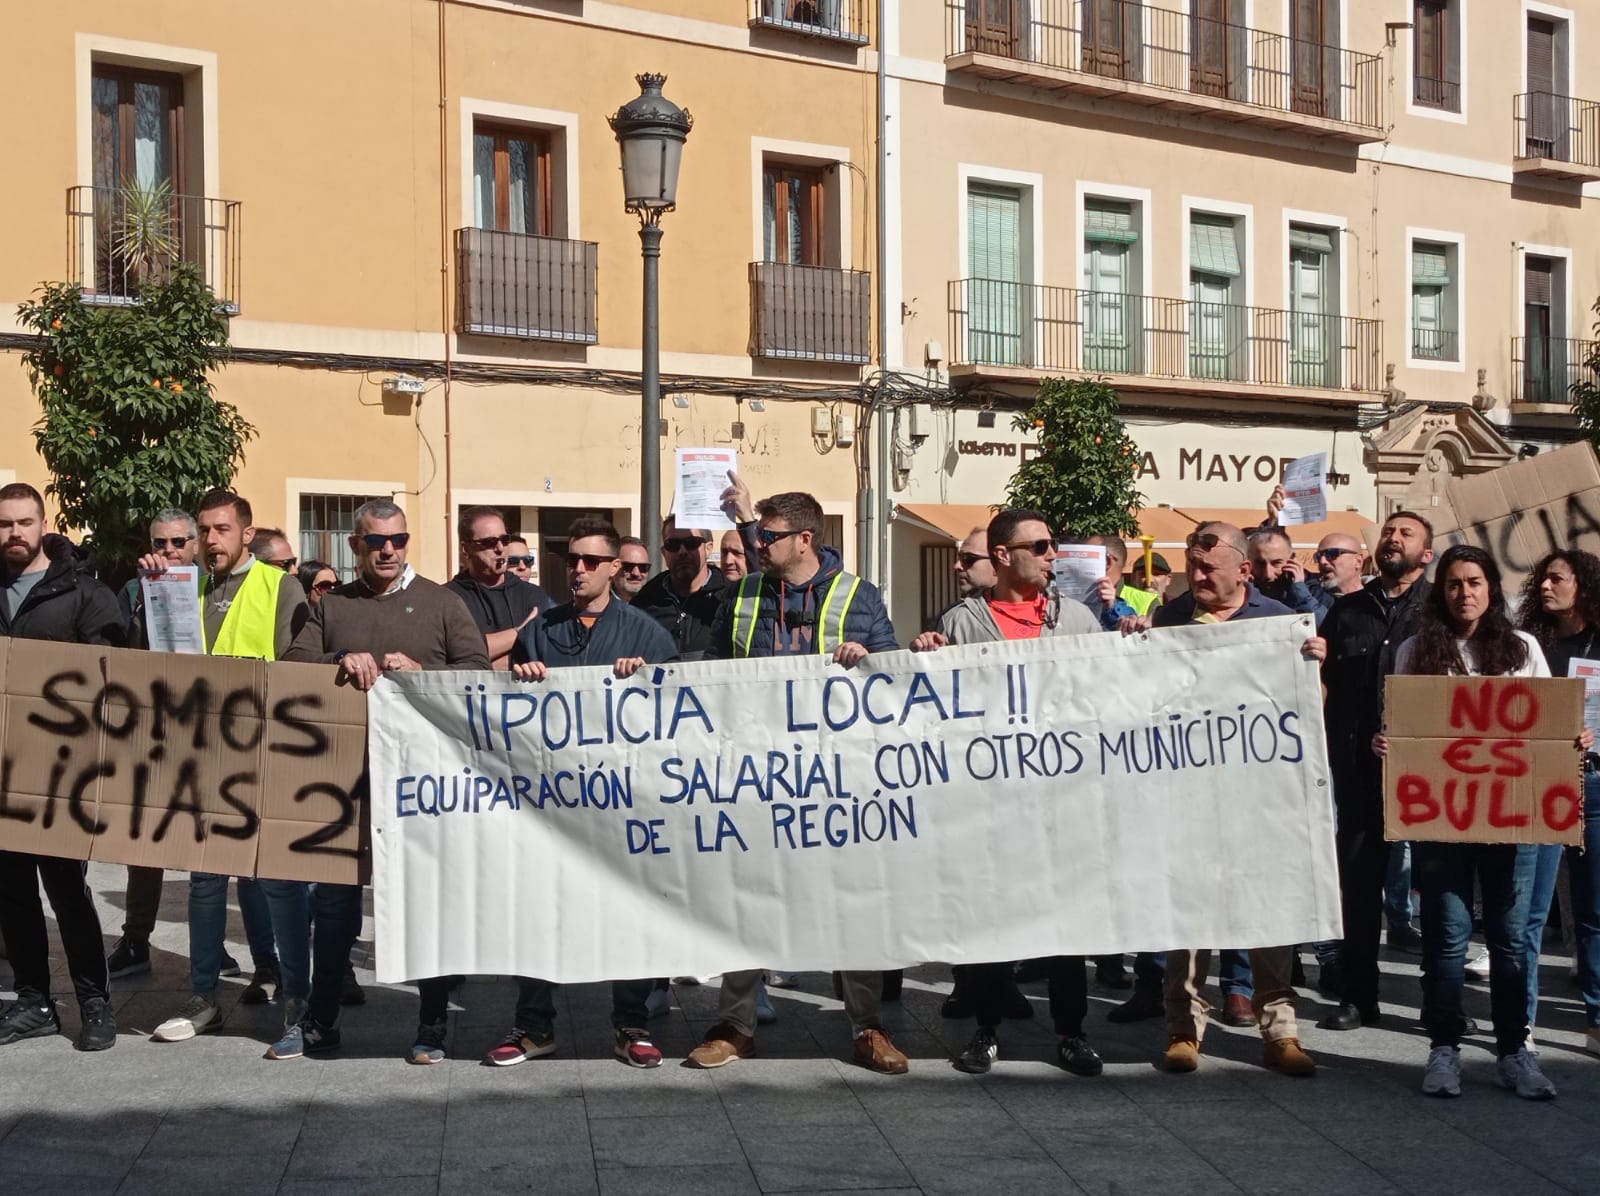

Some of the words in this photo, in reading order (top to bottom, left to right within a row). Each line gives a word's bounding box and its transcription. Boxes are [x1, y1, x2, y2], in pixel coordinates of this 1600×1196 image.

[28, 669, 331, 757] SOMOS
[787, 669, 985, 732] LOCAL
[1450, 679, 1541, 733] NO
[396, 763, 633, 818] EQUIPARACIÓN
[660, 744, 851, 805] SALARIAL
[874, 740, 950, 790] CON
[966, 731, 1084, 780] OTROS
[1100, 704, 1303, 776] MUNICIPIOS
[1442, 736, 1529, 777] ES
[626, 818, 671, 855] DE
[695, 811, 748, 854] LA
[772, 789, 918, 850] REGIÓN
[1396, 774, 1581, 832] BULO
